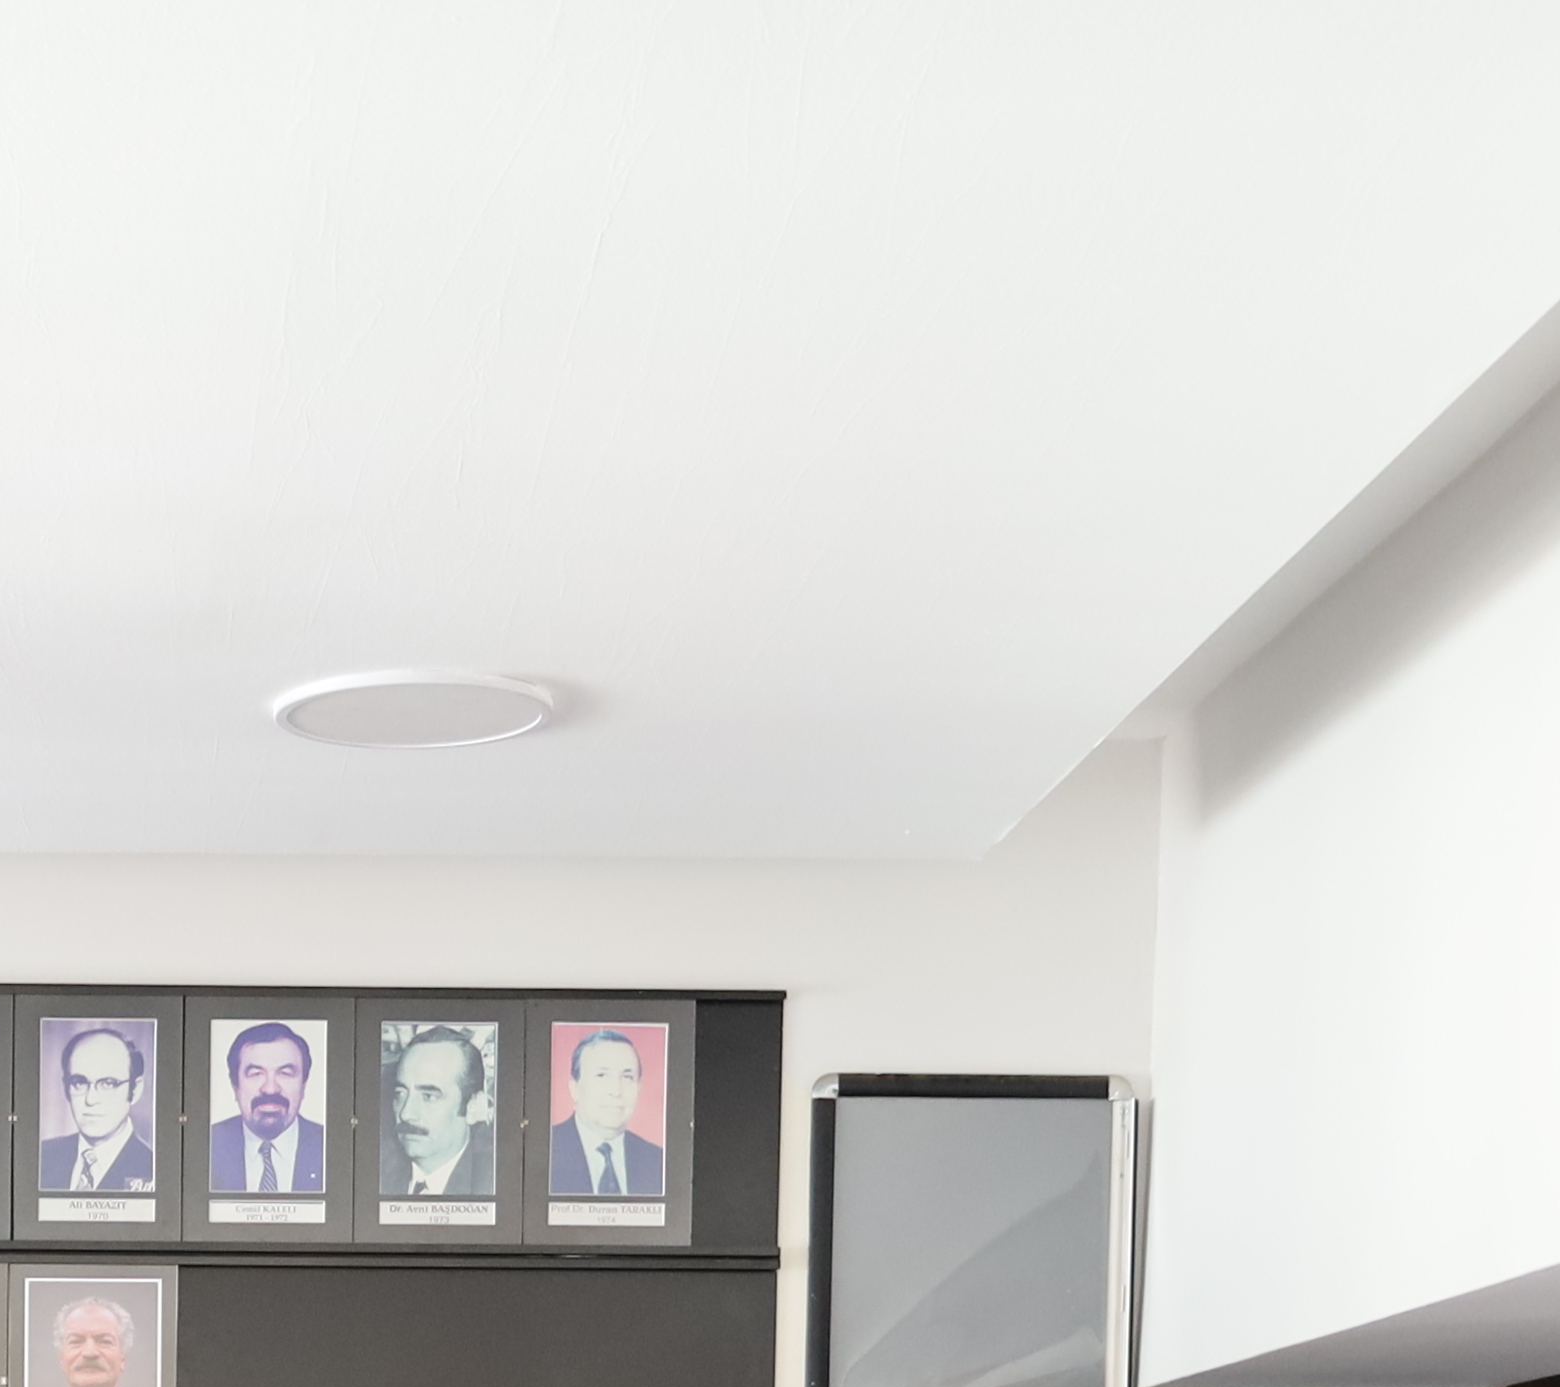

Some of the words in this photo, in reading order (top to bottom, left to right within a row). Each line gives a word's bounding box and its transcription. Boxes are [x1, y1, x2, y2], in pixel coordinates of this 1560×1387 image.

[69, 1201, 83, 1209] Ali
[235, 1204, 260, 1213] Cemil
[588, 1205, 618, 1213] Duran
[389, 1204, 404, 1213] Dr.
[431, 1203, 488, 1216] BAŞDOĞAN
[88, 1212, 108, 1220] 1970
